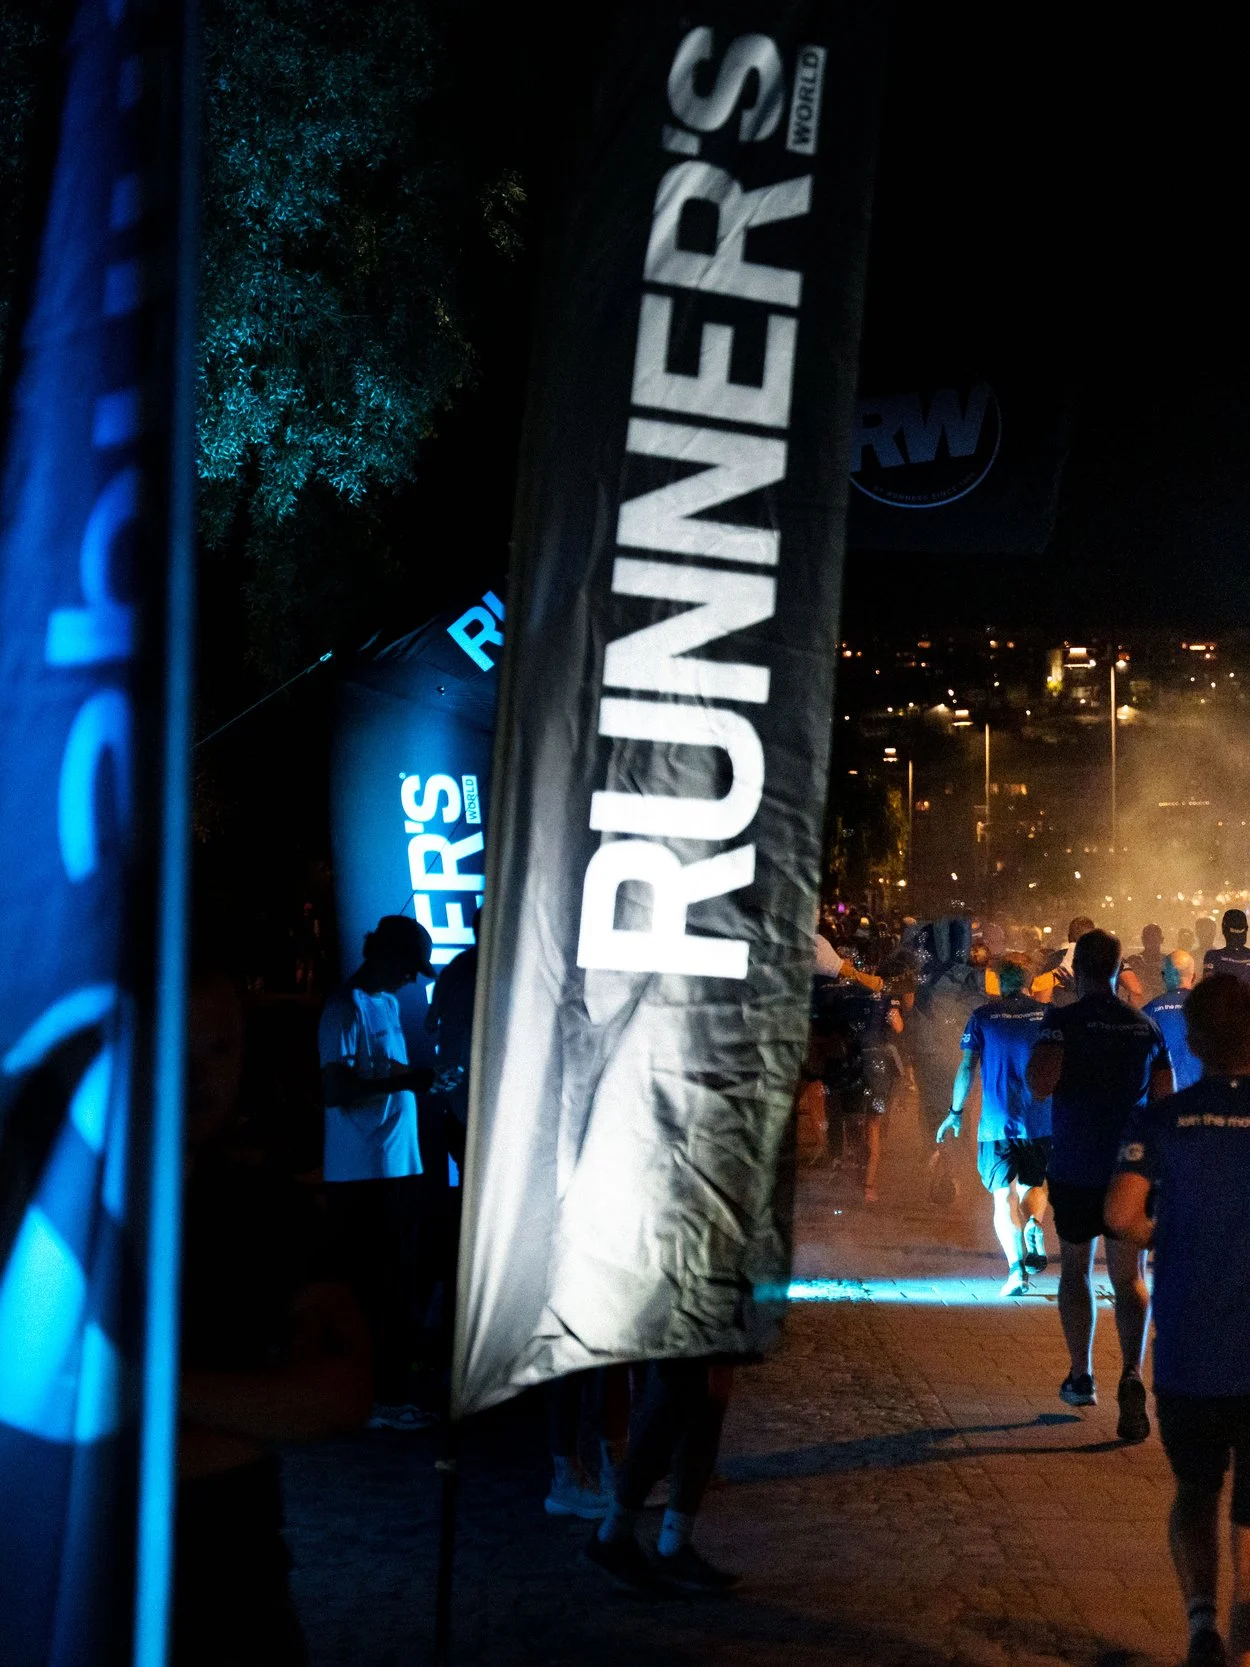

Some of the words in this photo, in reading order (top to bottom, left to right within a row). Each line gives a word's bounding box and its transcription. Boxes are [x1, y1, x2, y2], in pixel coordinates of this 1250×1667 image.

[793, 51, 819, 145] WORLD
[850, 380, 991, 473] RW
[576, 25, 814, 980] RUNNER'S
[464, 778, 478, 820] WORLD
